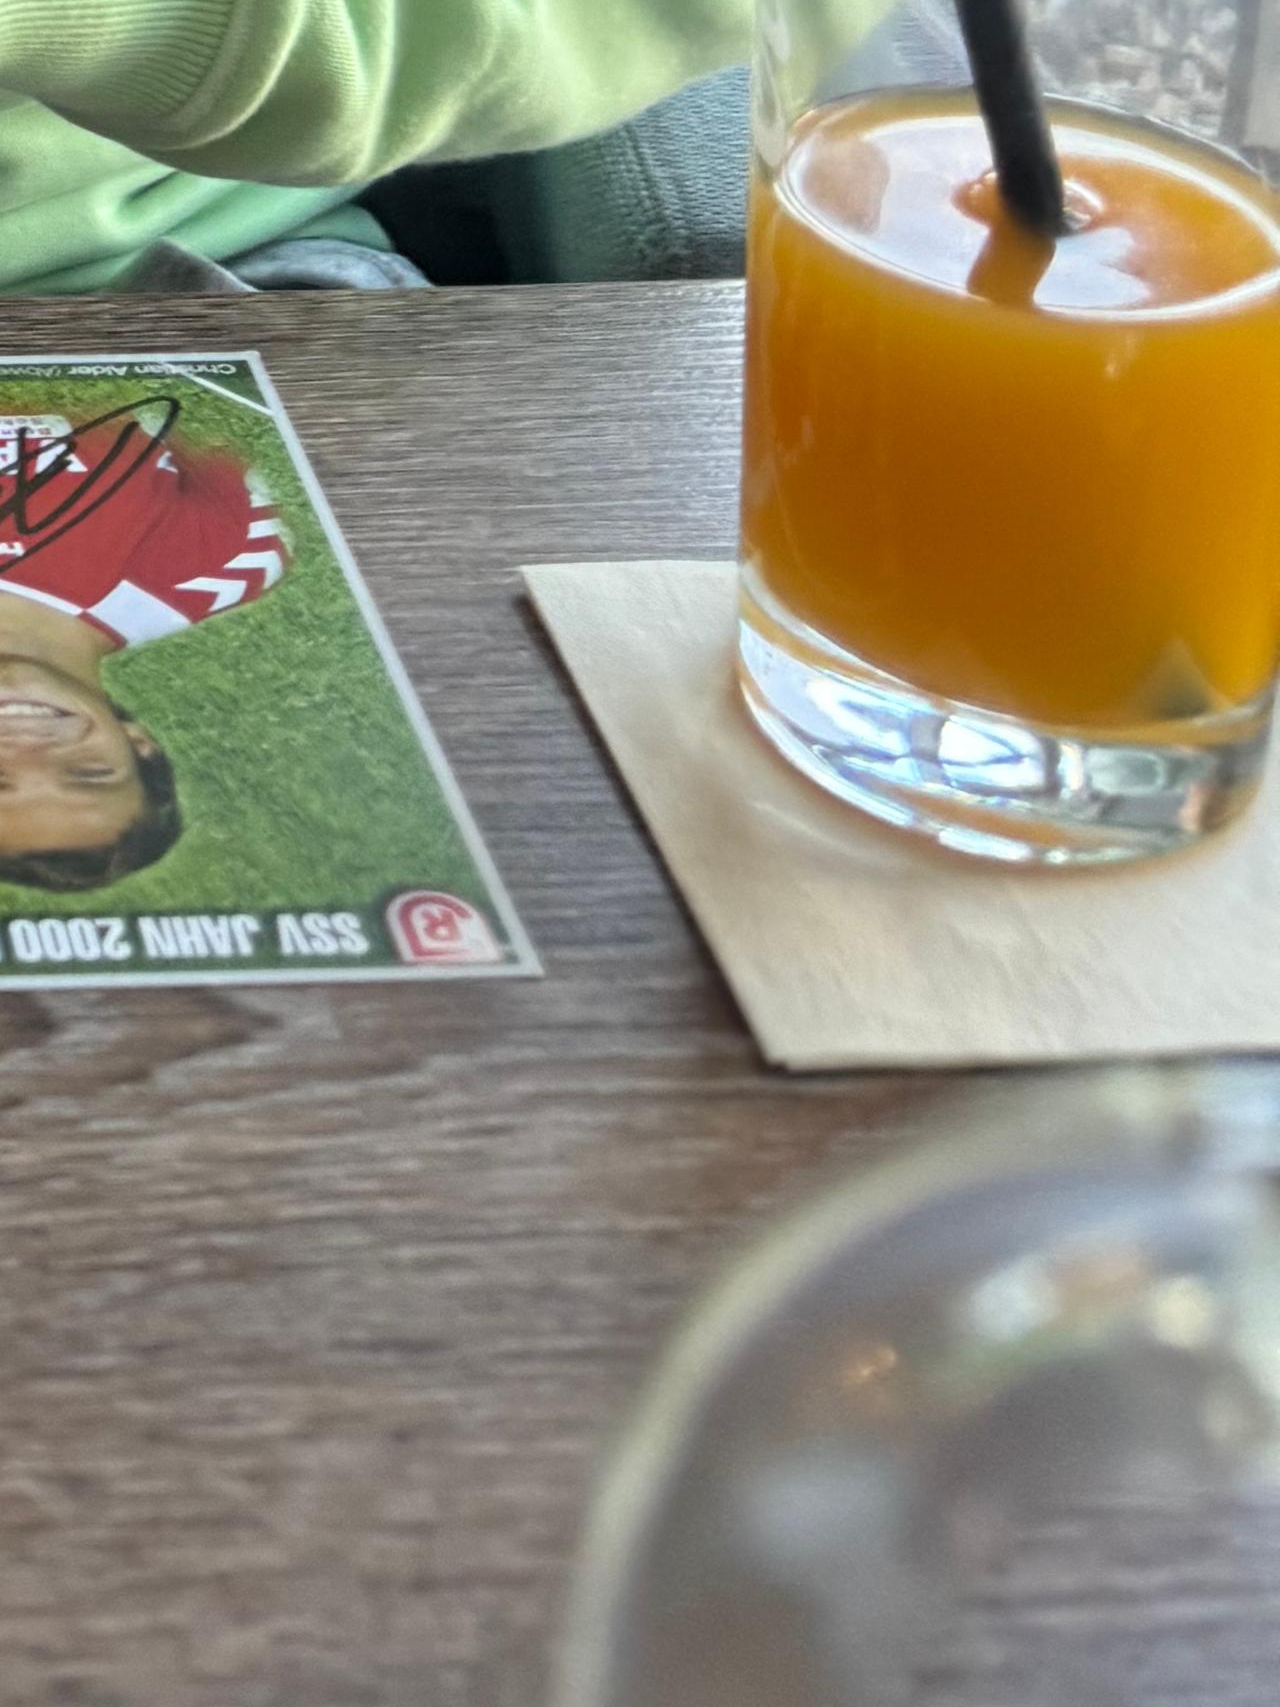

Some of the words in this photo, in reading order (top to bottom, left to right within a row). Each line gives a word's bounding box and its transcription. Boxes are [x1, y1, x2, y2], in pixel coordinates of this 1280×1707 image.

[7, 915, 131, 963] 2000
[137, 913, 264, 960] JAHN
[277, 912, 370, 958] SSV
